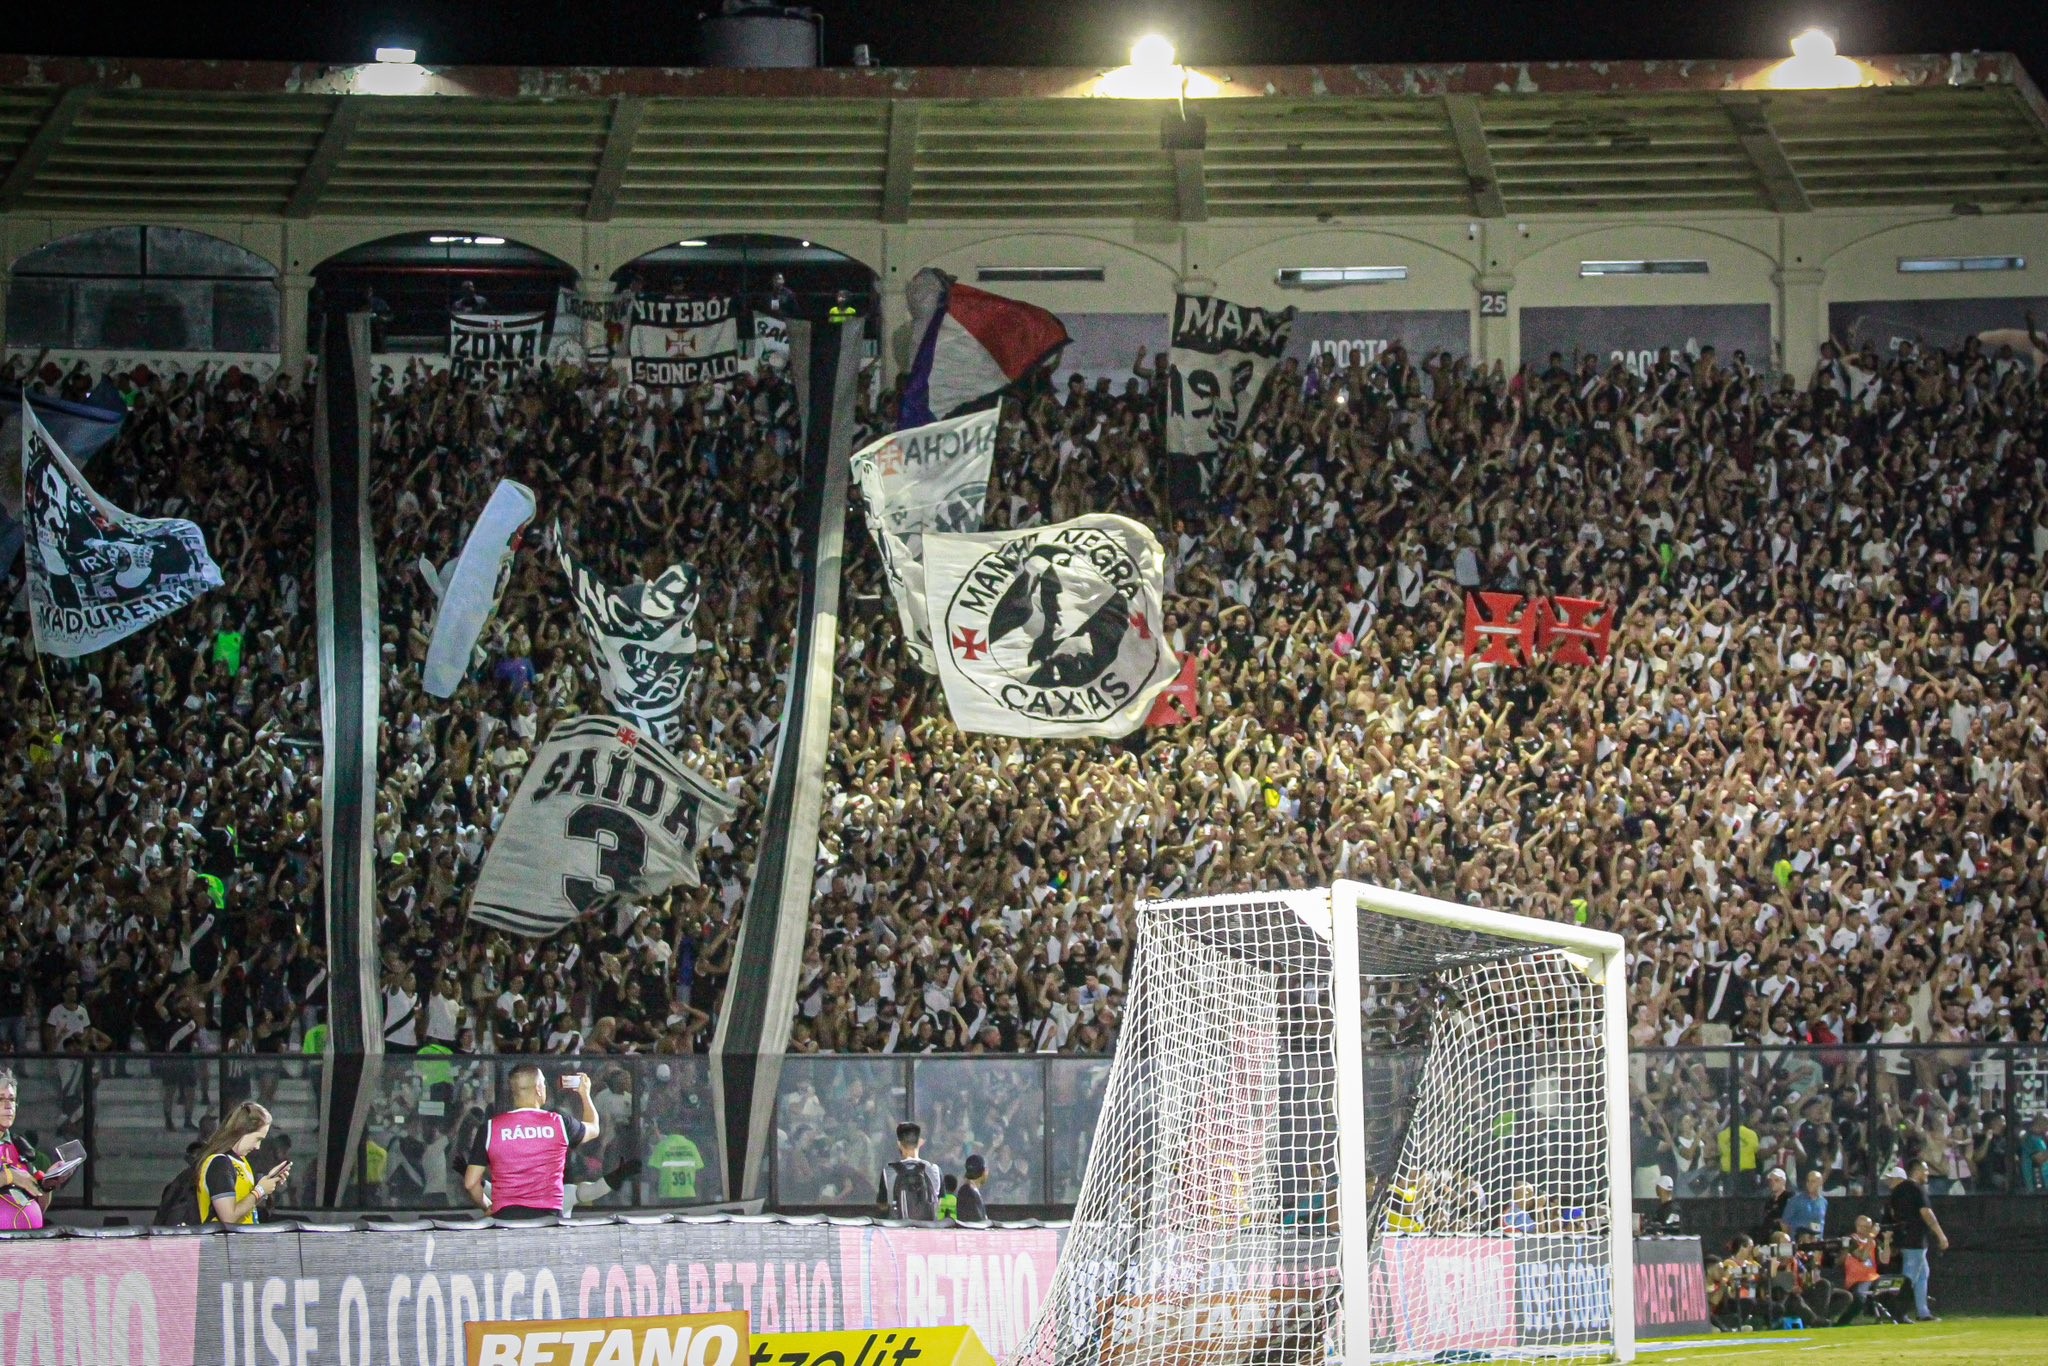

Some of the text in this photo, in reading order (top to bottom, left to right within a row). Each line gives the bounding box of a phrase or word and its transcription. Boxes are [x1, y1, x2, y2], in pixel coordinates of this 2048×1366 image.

[1481, 294, 1507, 313] 25
[453, 327, 537, 360] ZONA
[451, 356, 535, 390] OEST
[1053, 529, 1142, 601] NEGRA
[1001, 672, 1130, 717] CAXIAS
[562, 801, 650, 915] 3
[501, 1124, 555, 1141] RÁDIO
[1634, 1262, 1707, 1327] PABETANO
[222, 1277, 320, 1366] USE
[338, 1276, 371, 1366] O
[477, 1324, 737, 1366] BETANO
